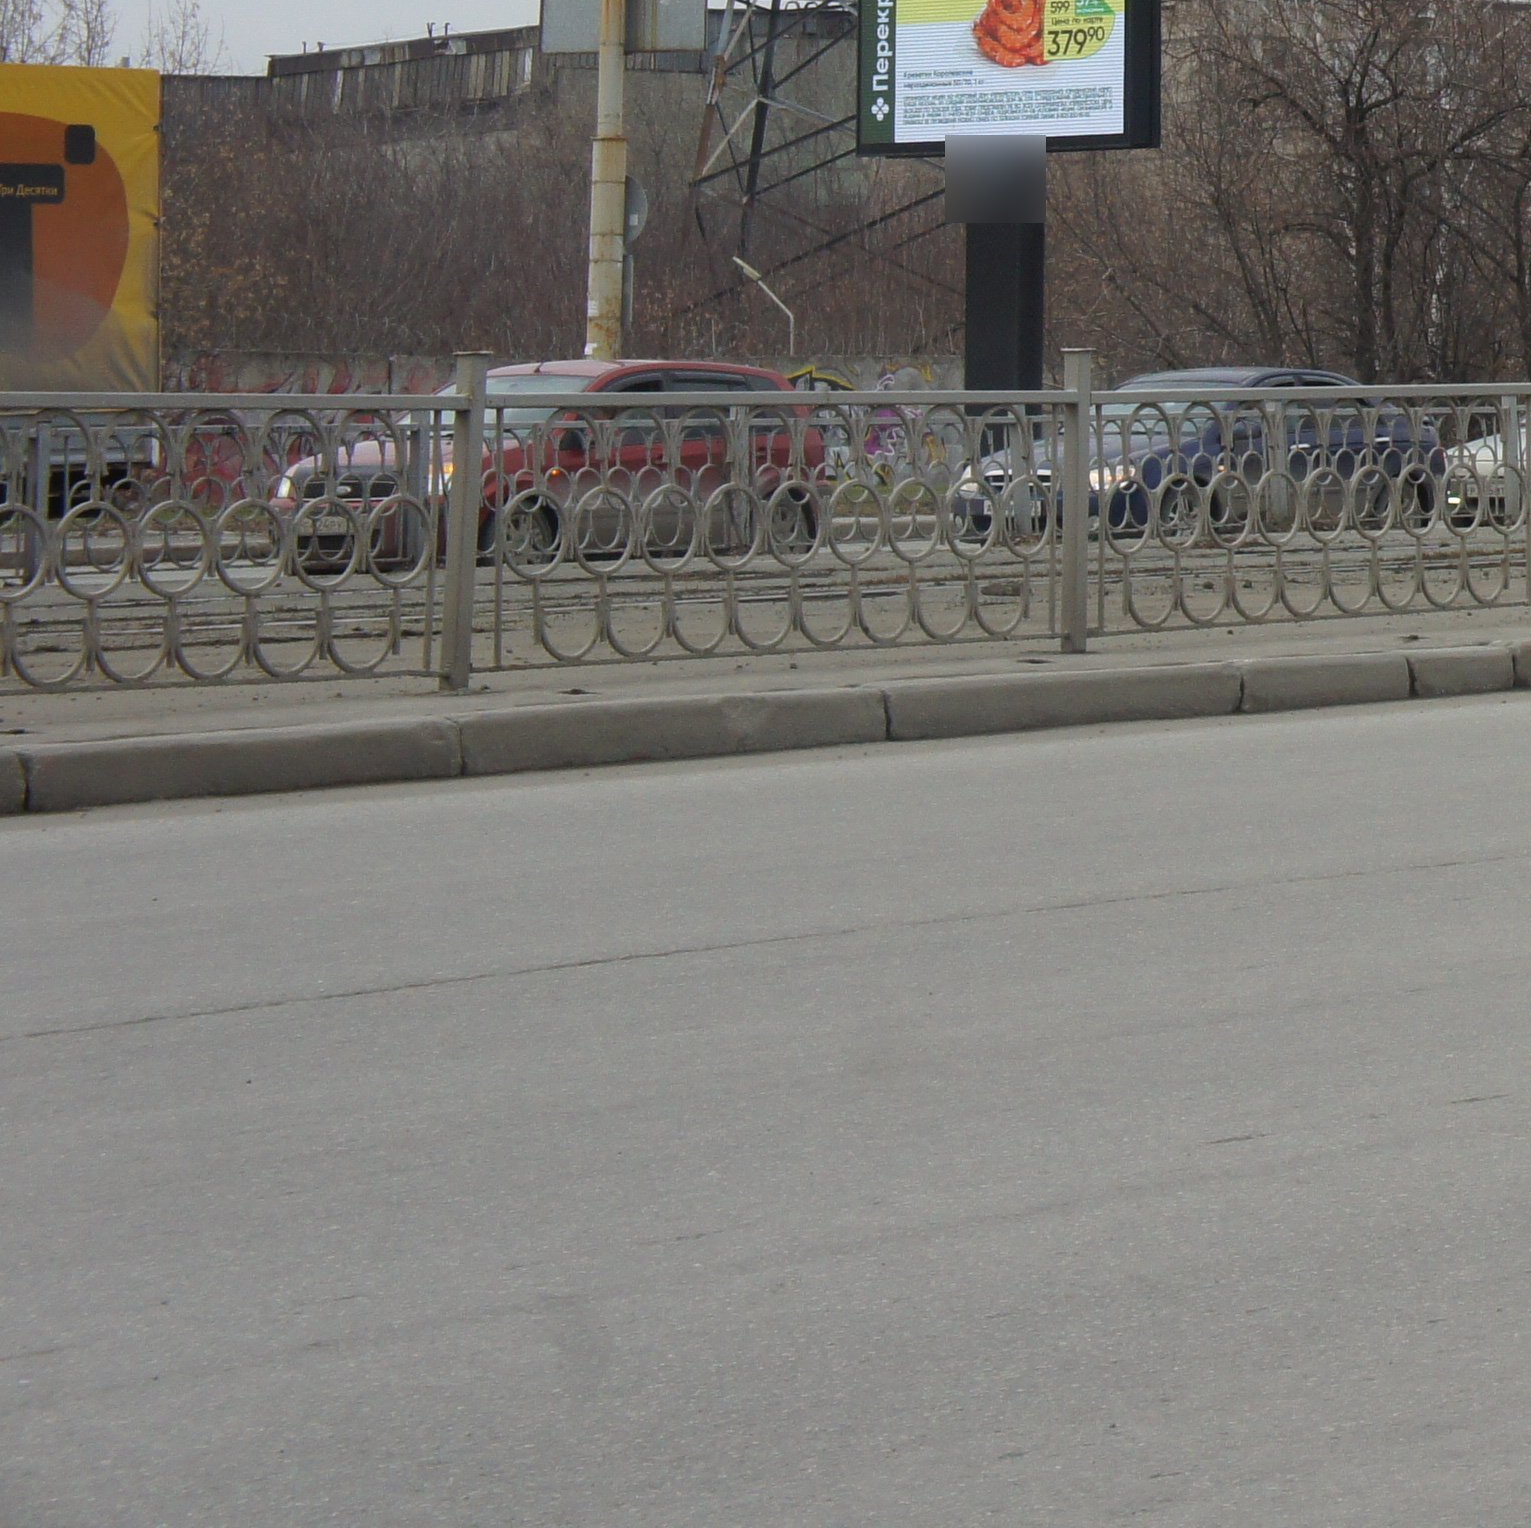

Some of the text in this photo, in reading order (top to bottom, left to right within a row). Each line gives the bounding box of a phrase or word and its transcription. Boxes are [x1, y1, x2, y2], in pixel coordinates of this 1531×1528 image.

[1050, 0, 1070, 13] 599
[1047, 26, 1105, 56] 379 90
[16, 183, 58, 198] Десятки
